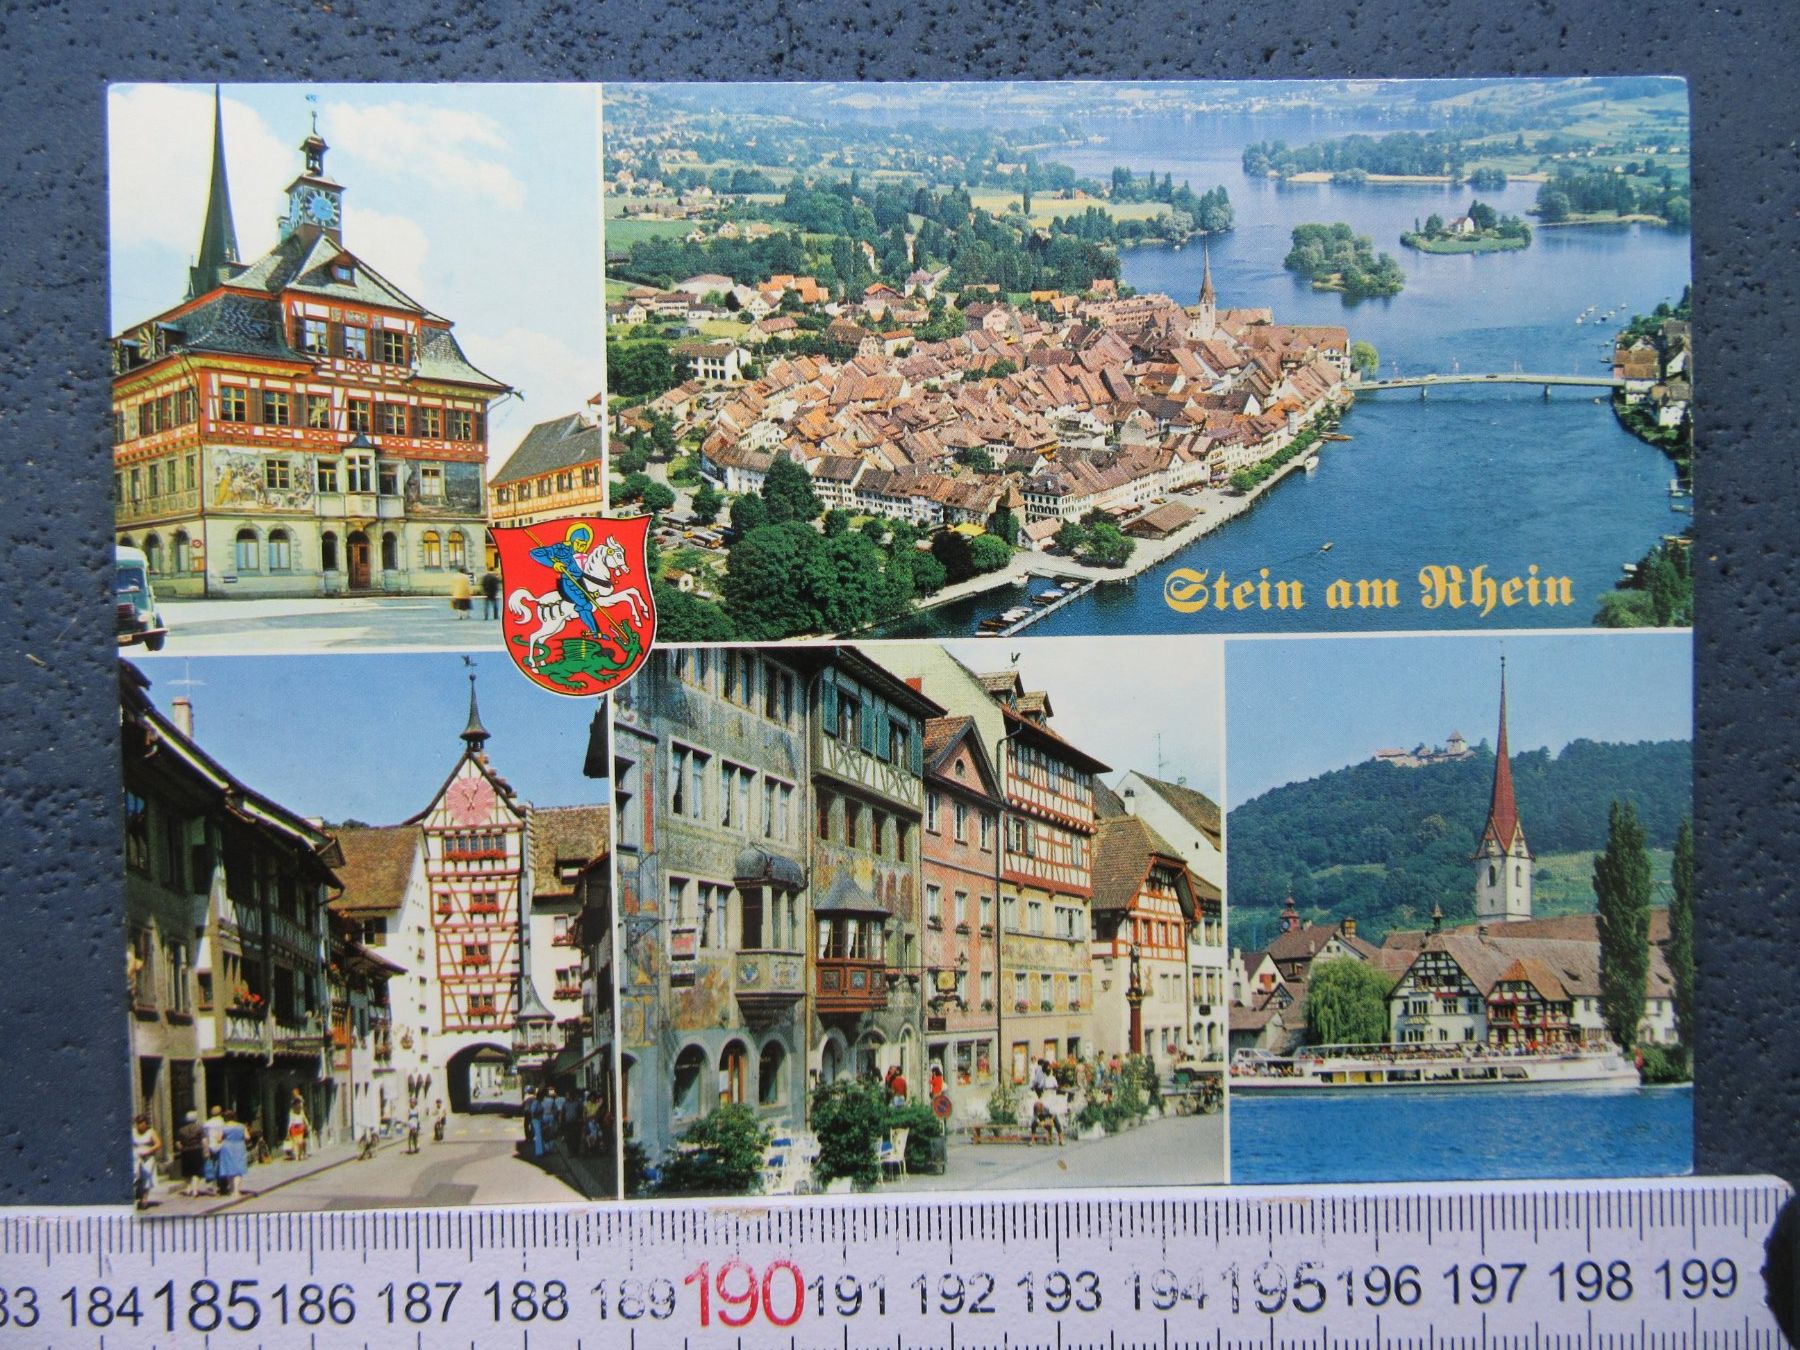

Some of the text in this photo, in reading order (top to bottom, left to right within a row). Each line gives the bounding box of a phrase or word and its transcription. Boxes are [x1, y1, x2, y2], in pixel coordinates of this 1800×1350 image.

[1163, 564, 1576, 618] Stein am Rhein
[61, 1286, 144, 1328] 184
[154, 1279, 261, 1332] 185
[272, 1283, 356, 1325] 186
[378, 1281, 462, 1323] 187
[484, 1280, 569, 1322] 188
[590, 1278, 676, 1320] 189
[684, 1258, 805, 1328] 190
[808, 1274, 886, 1316] 191
[911, 1271, 996, 1315] 192
[1017, 1270, 1102, 1313] 193
[1125, 1266, 1209, 1311] 194
[1221, 1261, 1327, 1314] 195
[1337, 1264, 1422, 1307] 196
[1443, 1263, 1528, 1305] 197
[1549, 1259, 1634, 1302] 198
[1655, 1257, 1738, 1300] 199
